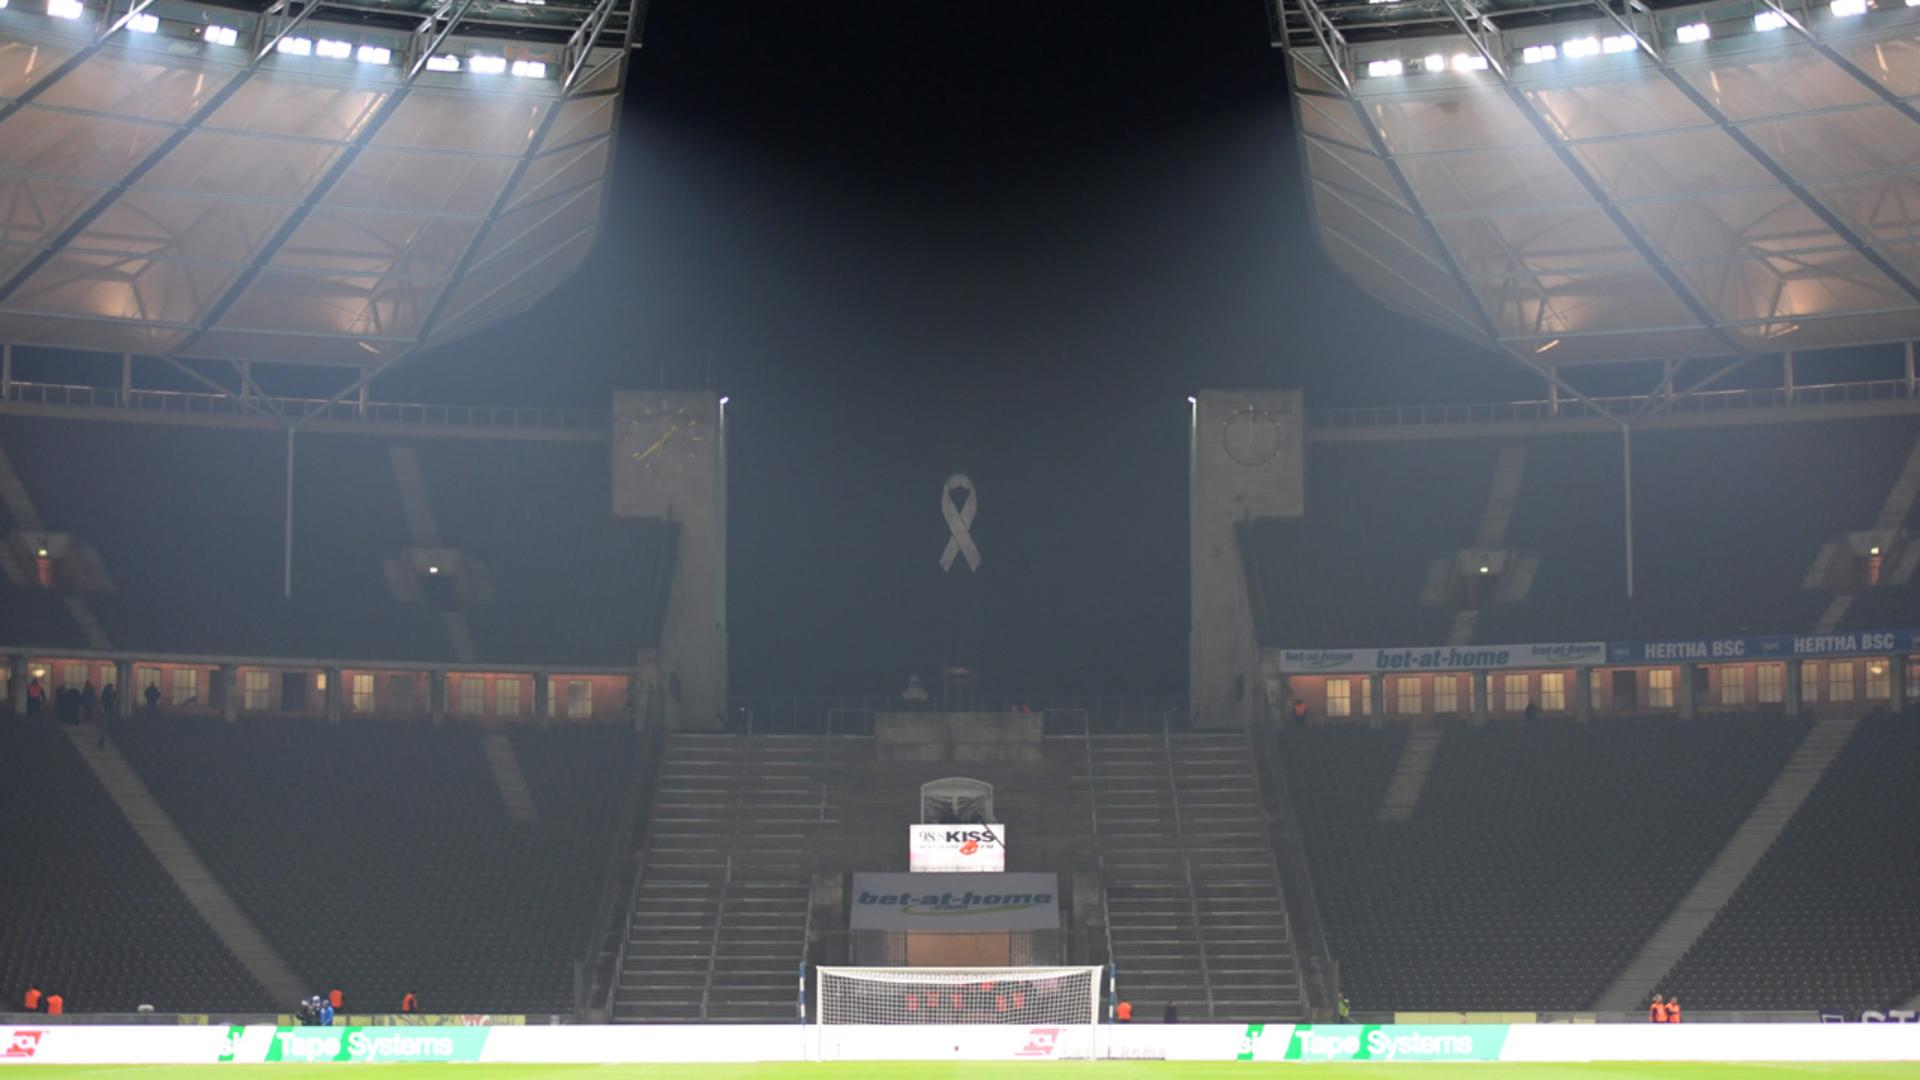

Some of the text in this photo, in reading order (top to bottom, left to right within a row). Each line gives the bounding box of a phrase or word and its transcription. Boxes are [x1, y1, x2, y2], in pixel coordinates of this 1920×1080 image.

[1645, 642, 1707, 659] HERTHA
[1712, 640, 1745, 656] BSC
[1794, 635, 1857, 653] HERTHA
[1862, 633, 1894, 650] BSC
[1376, 648, 1509, 669] bet-at-home
[945, 831, 998, 843] KISS
[858, 891, 1053, 906] bet-at-home
[275, 1032, 341, 1059] Tape
[347, 1031, 453, 1060] Systems
[1295, 1031, 1359, 1056] Tape
[1367, 1030, 1473, 1058] Systems
